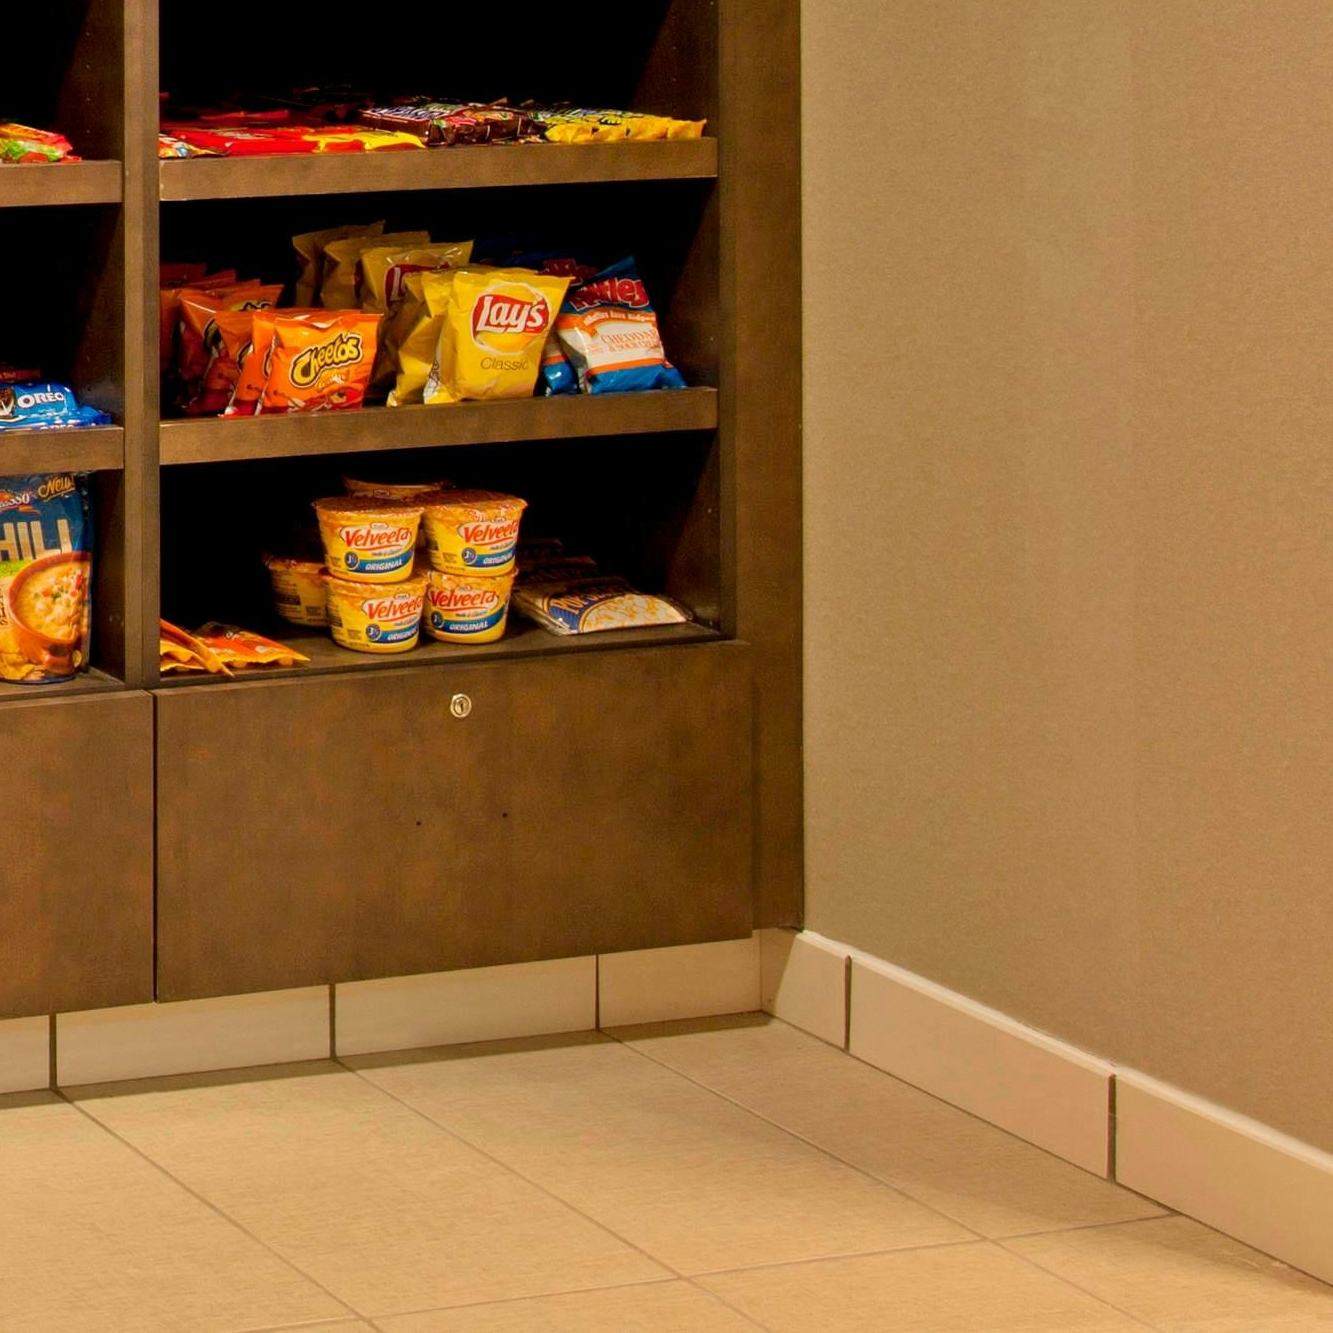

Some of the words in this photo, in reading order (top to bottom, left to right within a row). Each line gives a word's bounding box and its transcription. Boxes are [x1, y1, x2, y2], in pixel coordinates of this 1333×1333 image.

[476, 294, 546, 334] Lay's
[290, 332, 363, 388] Cheetos
[479, 357, 529, 371] Classic
[17, 393, 65, 409] OREO
[344, 526, 411, 548] Velveeta
[364, 559, 403, 571] ORIGINAL
[430, 590, 497, 609] Velveeta
[449, 620, 488, 631] ORIGINAL
